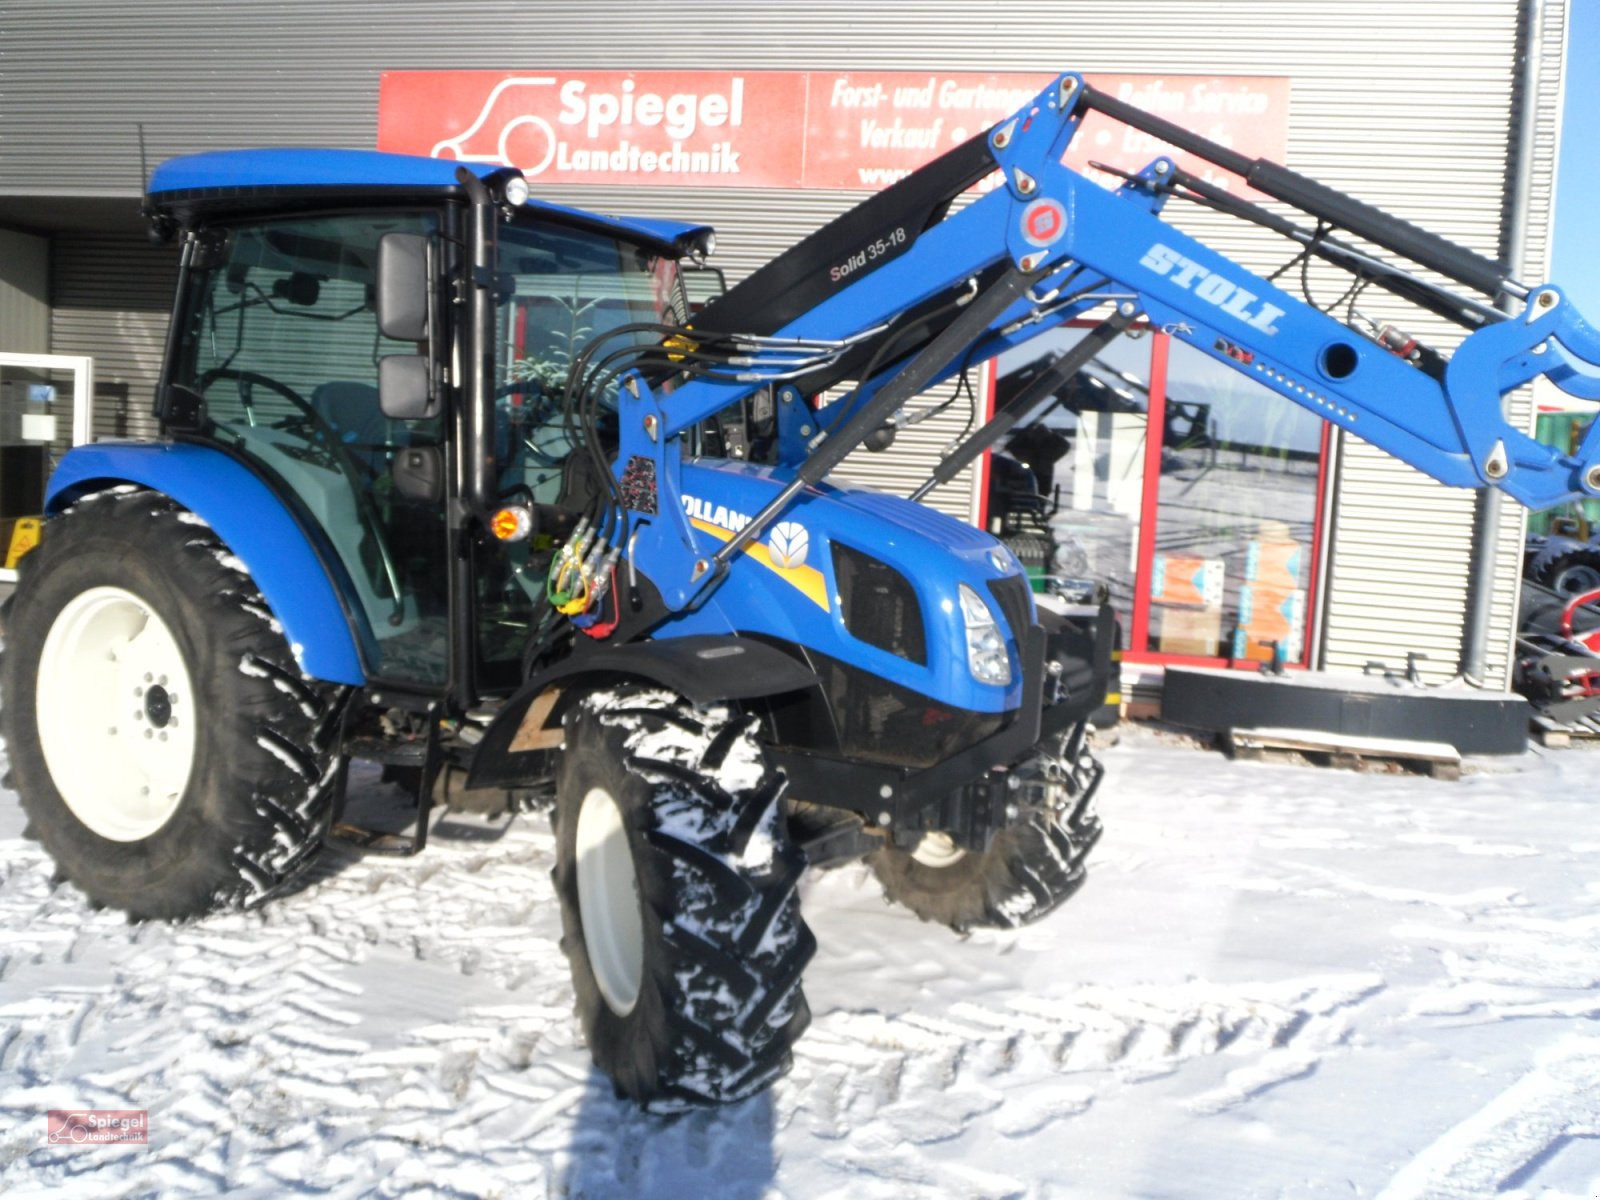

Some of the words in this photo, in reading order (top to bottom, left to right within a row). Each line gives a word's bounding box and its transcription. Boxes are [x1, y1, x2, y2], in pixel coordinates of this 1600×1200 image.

[558, 77, 744, 139] Spiegel
[831, 78, 888, 107] Forst-
[893, 77, 935, 107] und
[1188, 83, 1268, 113] Service
[860, 117, 943, 149] Verkauf
[556, 140, 741, 173] Landtechnik
[830, 250, 867, 281] Solid
[867, 227, 906, 259] 35-18
[1139, 243, 1286, 336] STOLL
[681, 494, 753, 533] OLLAN
